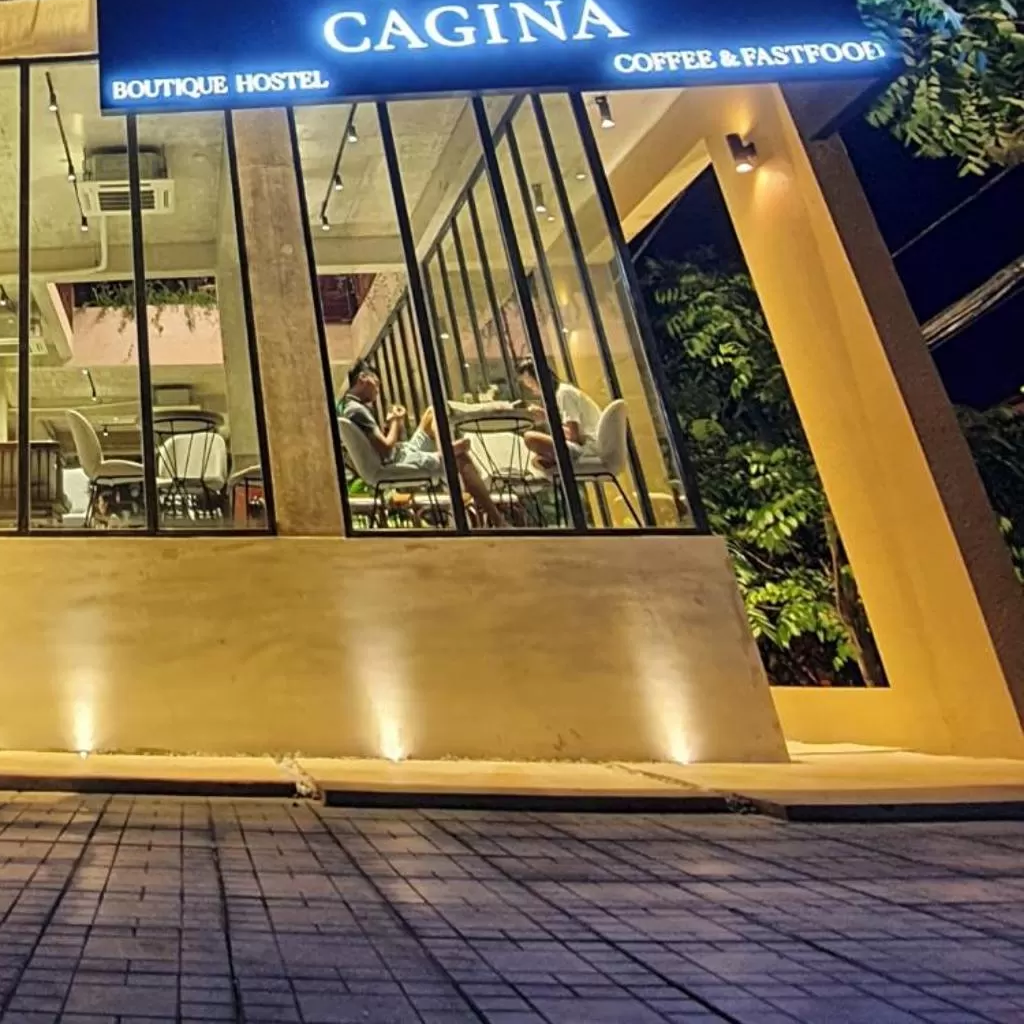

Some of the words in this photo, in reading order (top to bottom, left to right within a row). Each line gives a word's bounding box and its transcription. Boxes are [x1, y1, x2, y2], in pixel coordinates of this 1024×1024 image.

[613, 49, 716, 74] COFFEE
[111, 74, 228, 100] BOUTIQUE
[235, 70, 330, 92] HOSTEL
